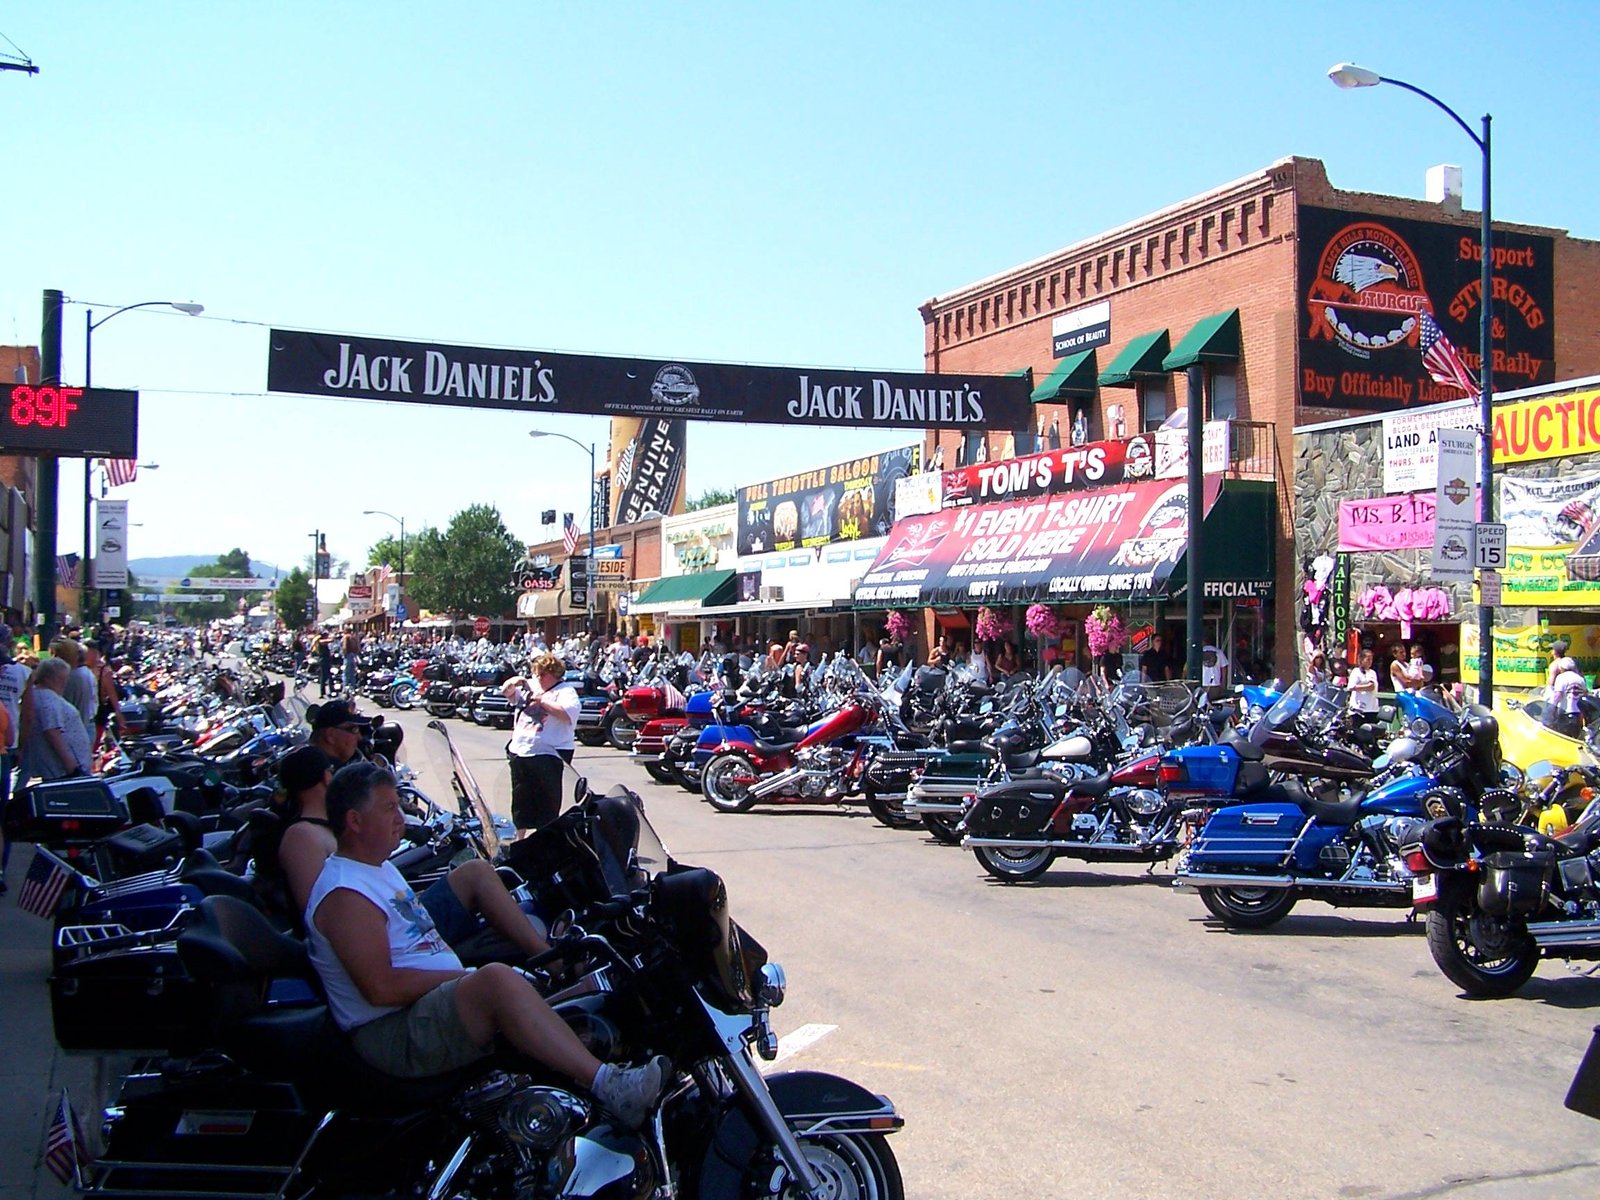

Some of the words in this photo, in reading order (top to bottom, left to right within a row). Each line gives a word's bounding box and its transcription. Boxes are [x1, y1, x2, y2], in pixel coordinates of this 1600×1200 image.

[1366, 229, 1396, 247] MOTOR
[1459, 236, 1535, 270] Suport
[1491, 350, 1542, 381] Rally
[1304, 368, 1335, 400] Buy
[1340, 371, 1413, 406] Officially
[1417, 378, 1470, 401] Licens
[11, 386, 83, 427] 89F
[1388, 432, 1421, 450] LAND
[829, 455, 880, 485] SALOON
[978, 456, 1053, 497] TOM'S
[1061, 447, 1106, 484] T'S
[971, 504, 1047, 537] EVENT
[1041, 491, 1137, 529] T-SHIRT
[1477, 527, 1505, 536] SPEED
[1479, 537, 1502, 546] LIMIT
[963, 534, 1023, 562] SOLD
[1018, 527, 1087, 558] HERE
[1480, 547, 1502, 564] 15
[598, 561, 626, 573] ESIDE
[1540, 552, 1567, 571] CO
[524, 579, 554, 589] OASIS
[1203, 581, 1257, 597] FFICIAL
[1334, 553, 1347, 643] TATTOOS
